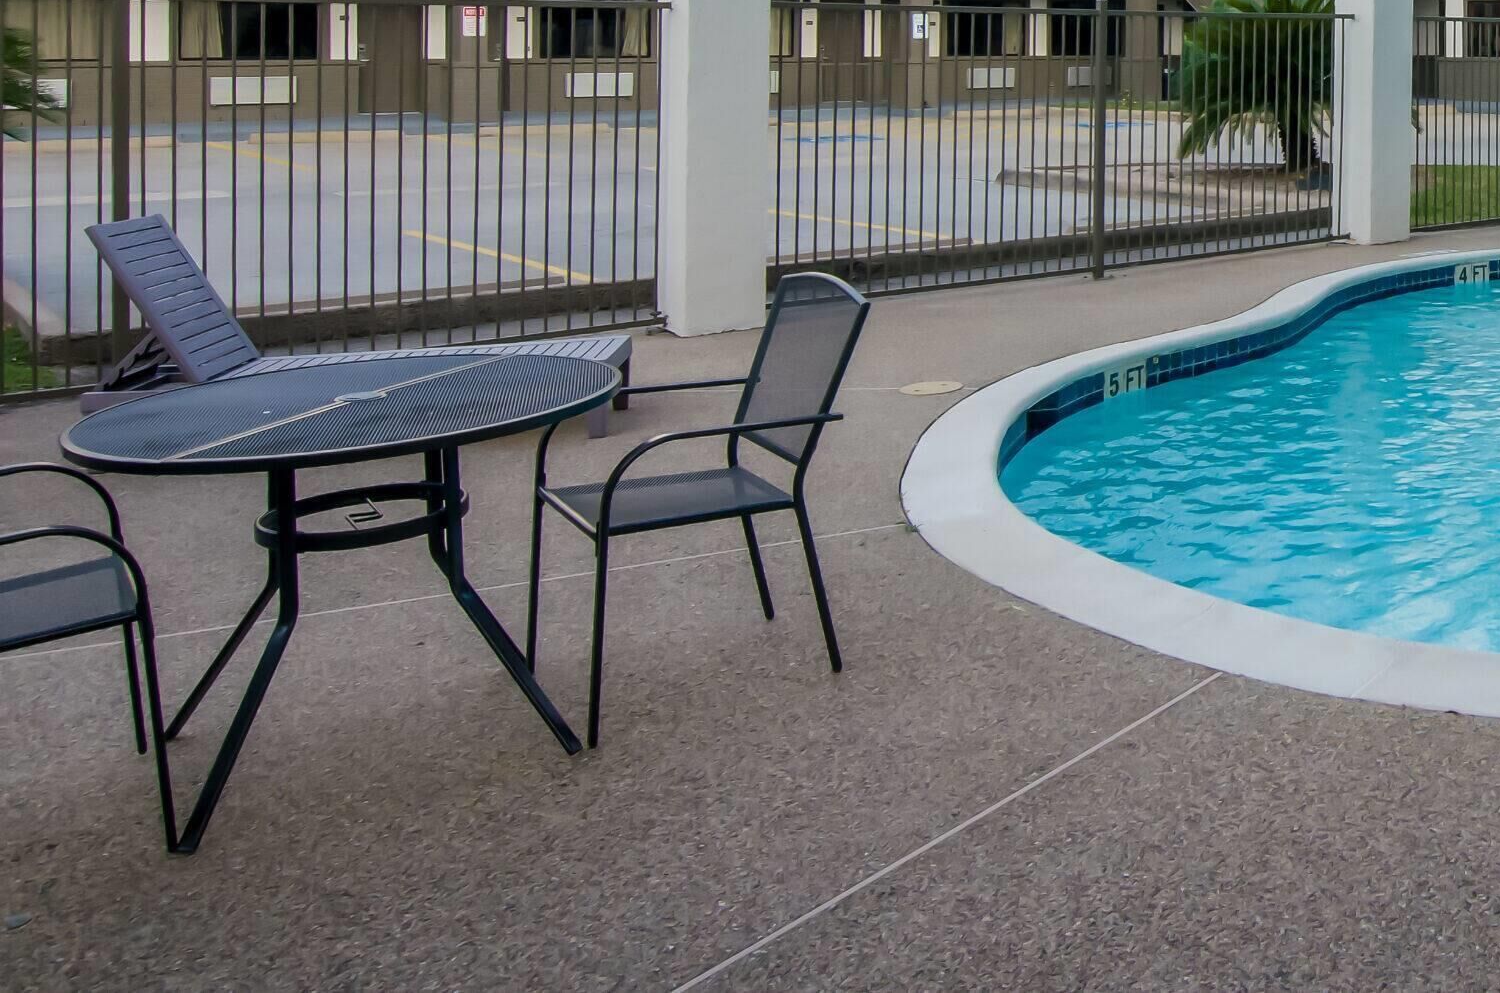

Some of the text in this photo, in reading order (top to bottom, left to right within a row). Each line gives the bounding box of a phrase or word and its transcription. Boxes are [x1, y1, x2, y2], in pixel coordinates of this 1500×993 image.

[1459, 264, 1487, 284] 4 FT
[1110, 365, 1144, 396] 5 FT
